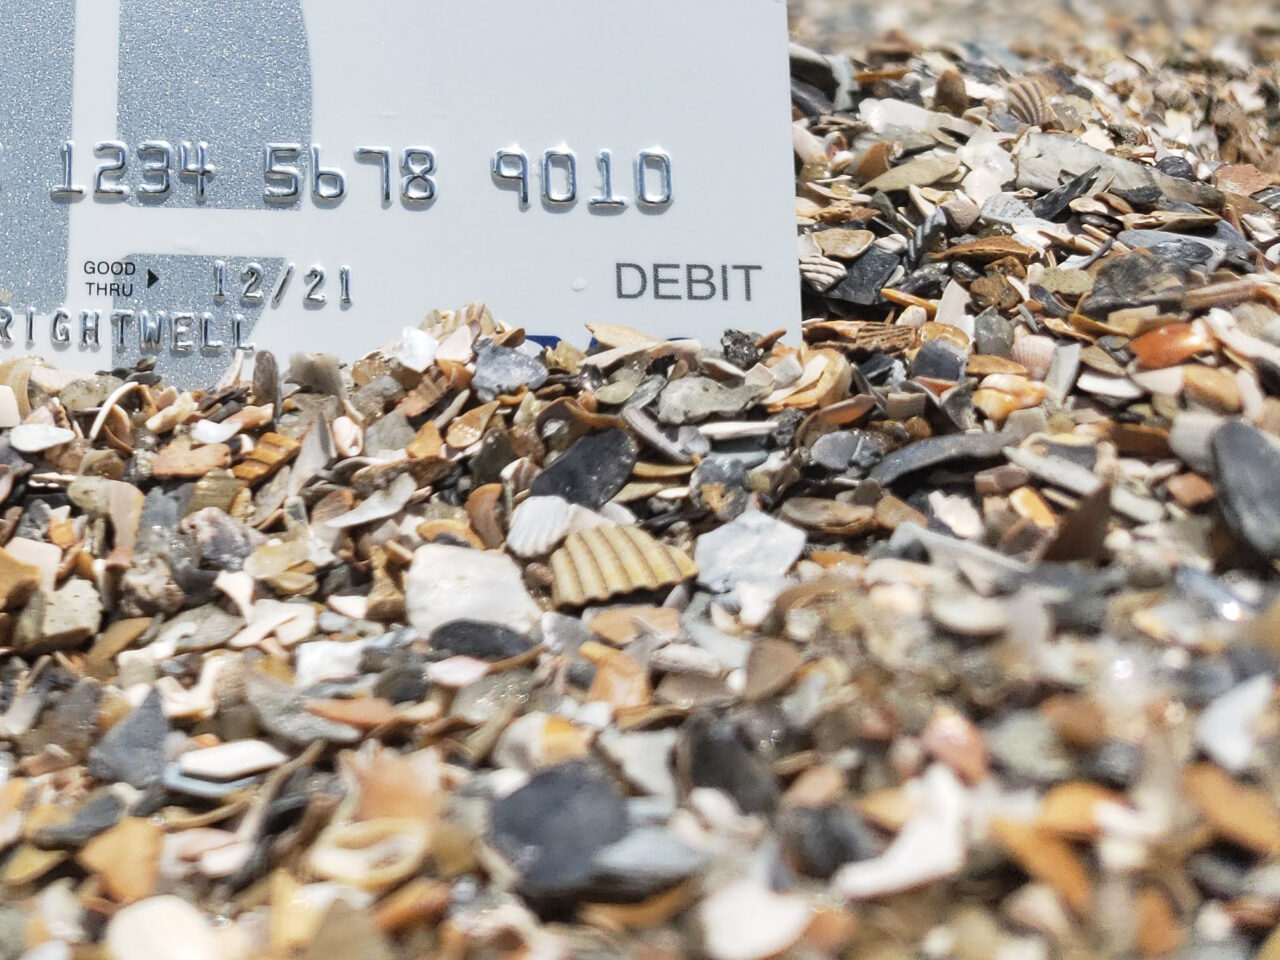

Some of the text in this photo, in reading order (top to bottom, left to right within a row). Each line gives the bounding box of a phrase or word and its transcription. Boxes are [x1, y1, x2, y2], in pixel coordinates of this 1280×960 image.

[51, 139, 215, 201] 1234
[262, 141, 439, 208] 5678
[491, 142, 675, 210] 9010
[83, 260, 137, 276] GOOD
[212, 259, 354, 310] 12/21
[615, 262, 763, 301] DEBIT
[85, 282, 134, 298] THRU
